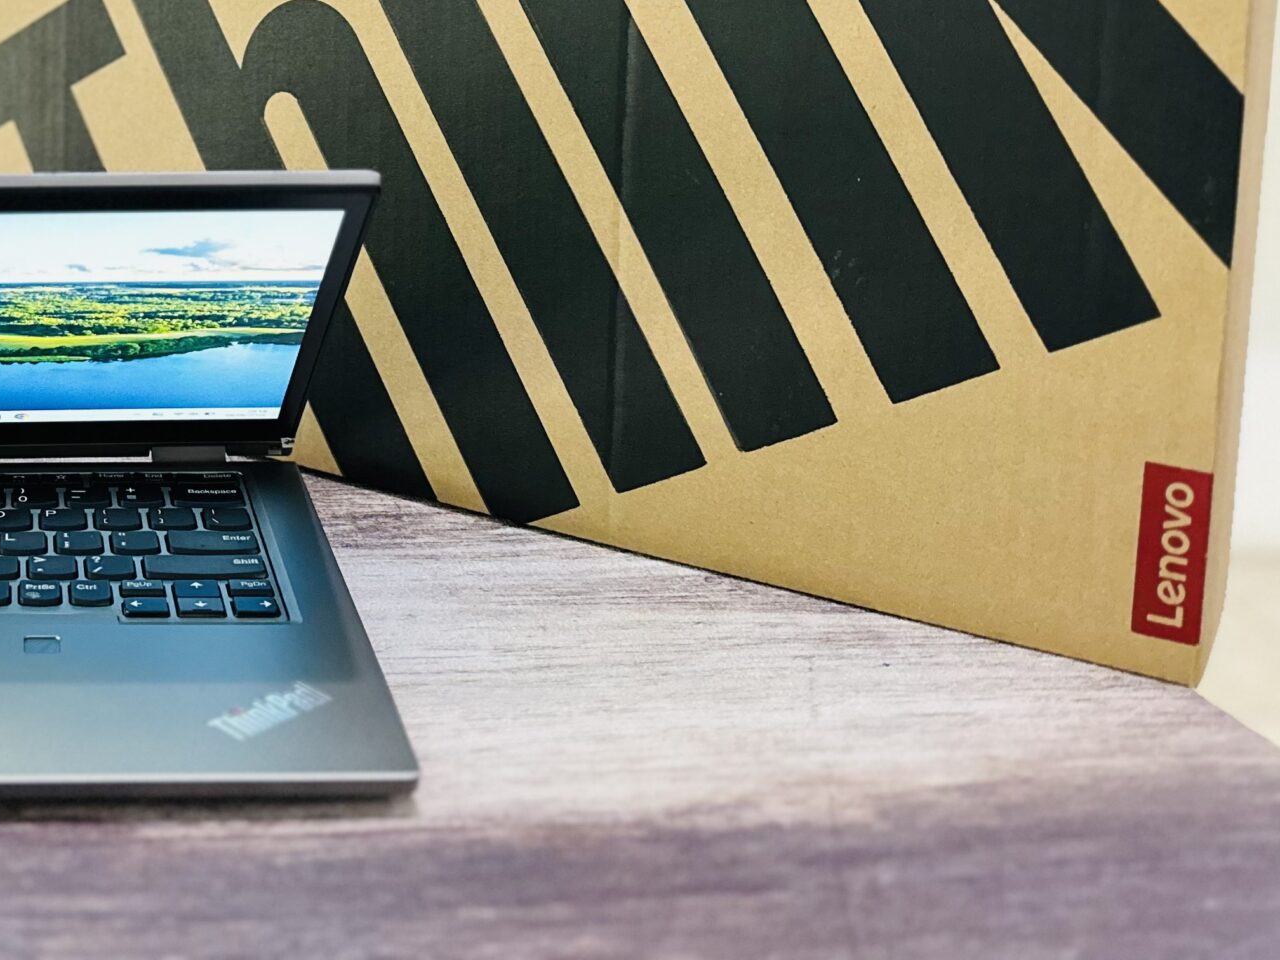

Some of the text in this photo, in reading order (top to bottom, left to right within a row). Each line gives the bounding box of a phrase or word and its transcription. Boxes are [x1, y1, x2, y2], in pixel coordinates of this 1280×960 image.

[45, 509, 57, 517] P
[4, 532, 16, 542] L
[1145, 481, 1195, 629] Lenovo
[232, 557, 261, 565] Shift
[76, 583, 97, 591] Ctrl
[125, 580, 153, 589] PgUp
[240, 580, 268, 588] PgDn
